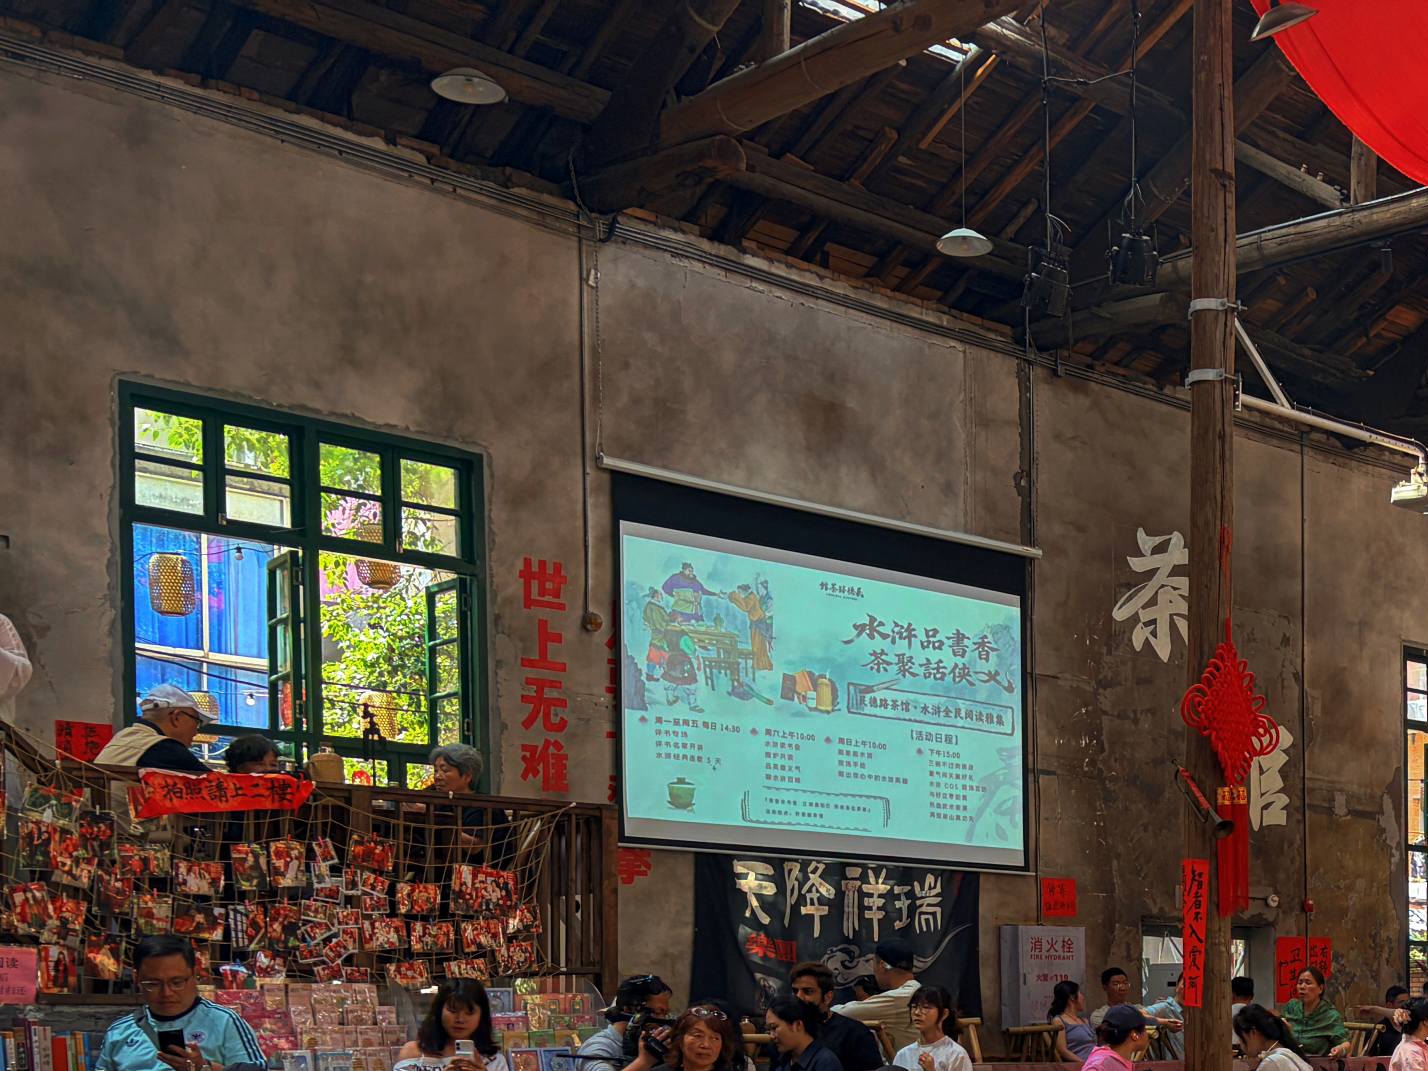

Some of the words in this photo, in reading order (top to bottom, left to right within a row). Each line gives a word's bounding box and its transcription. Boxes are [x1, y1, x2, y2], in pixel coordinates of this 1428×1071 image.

[518, 557, 570, 794] 世上无难
[732, 859, 943, 942] 天降祥瑞
[1030, 936, 1074, 954] 消火栓
